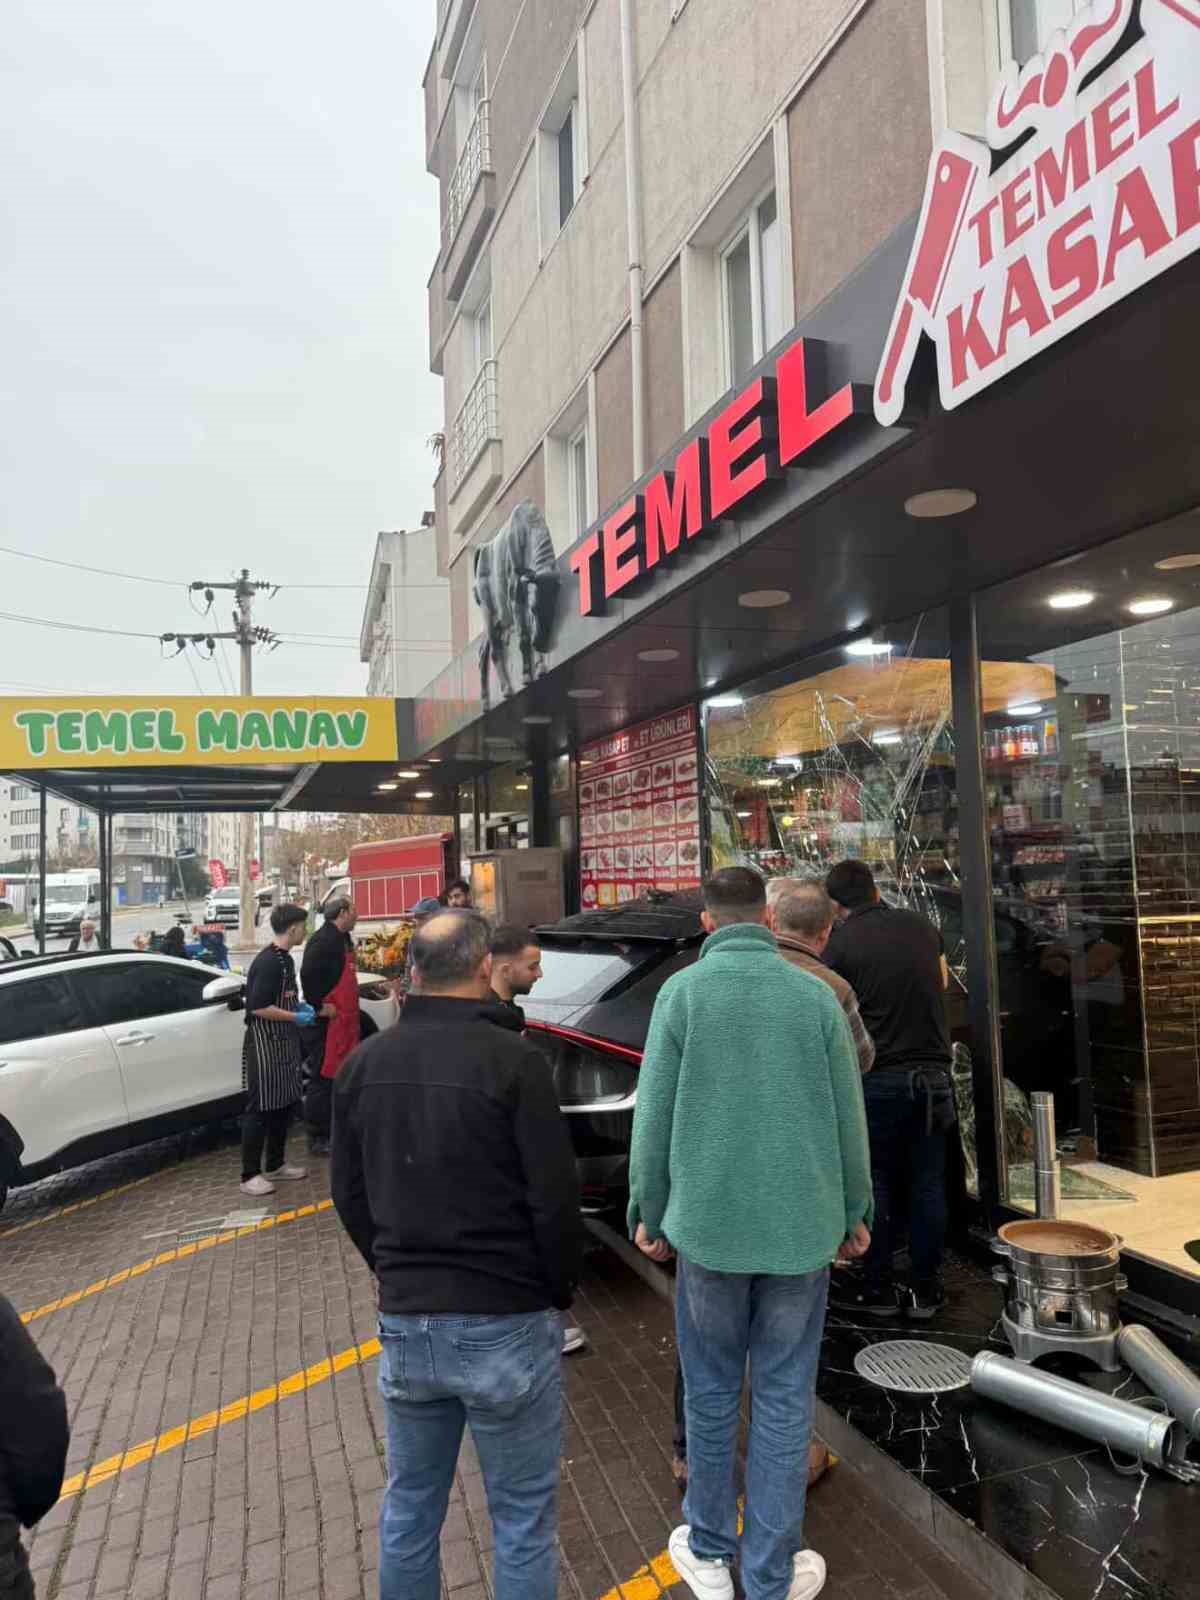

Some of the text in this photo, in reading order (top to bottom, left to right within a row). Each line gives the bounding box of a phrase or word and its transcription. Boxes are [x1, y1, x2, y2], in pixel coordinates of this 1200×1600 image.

[968, 58, 1181, 269] TEMEL
[569, 336, 853, 616] TEMEL
[15, 708, 186, 755] TEMEL
[197, 708, 368, 751] MANAV
